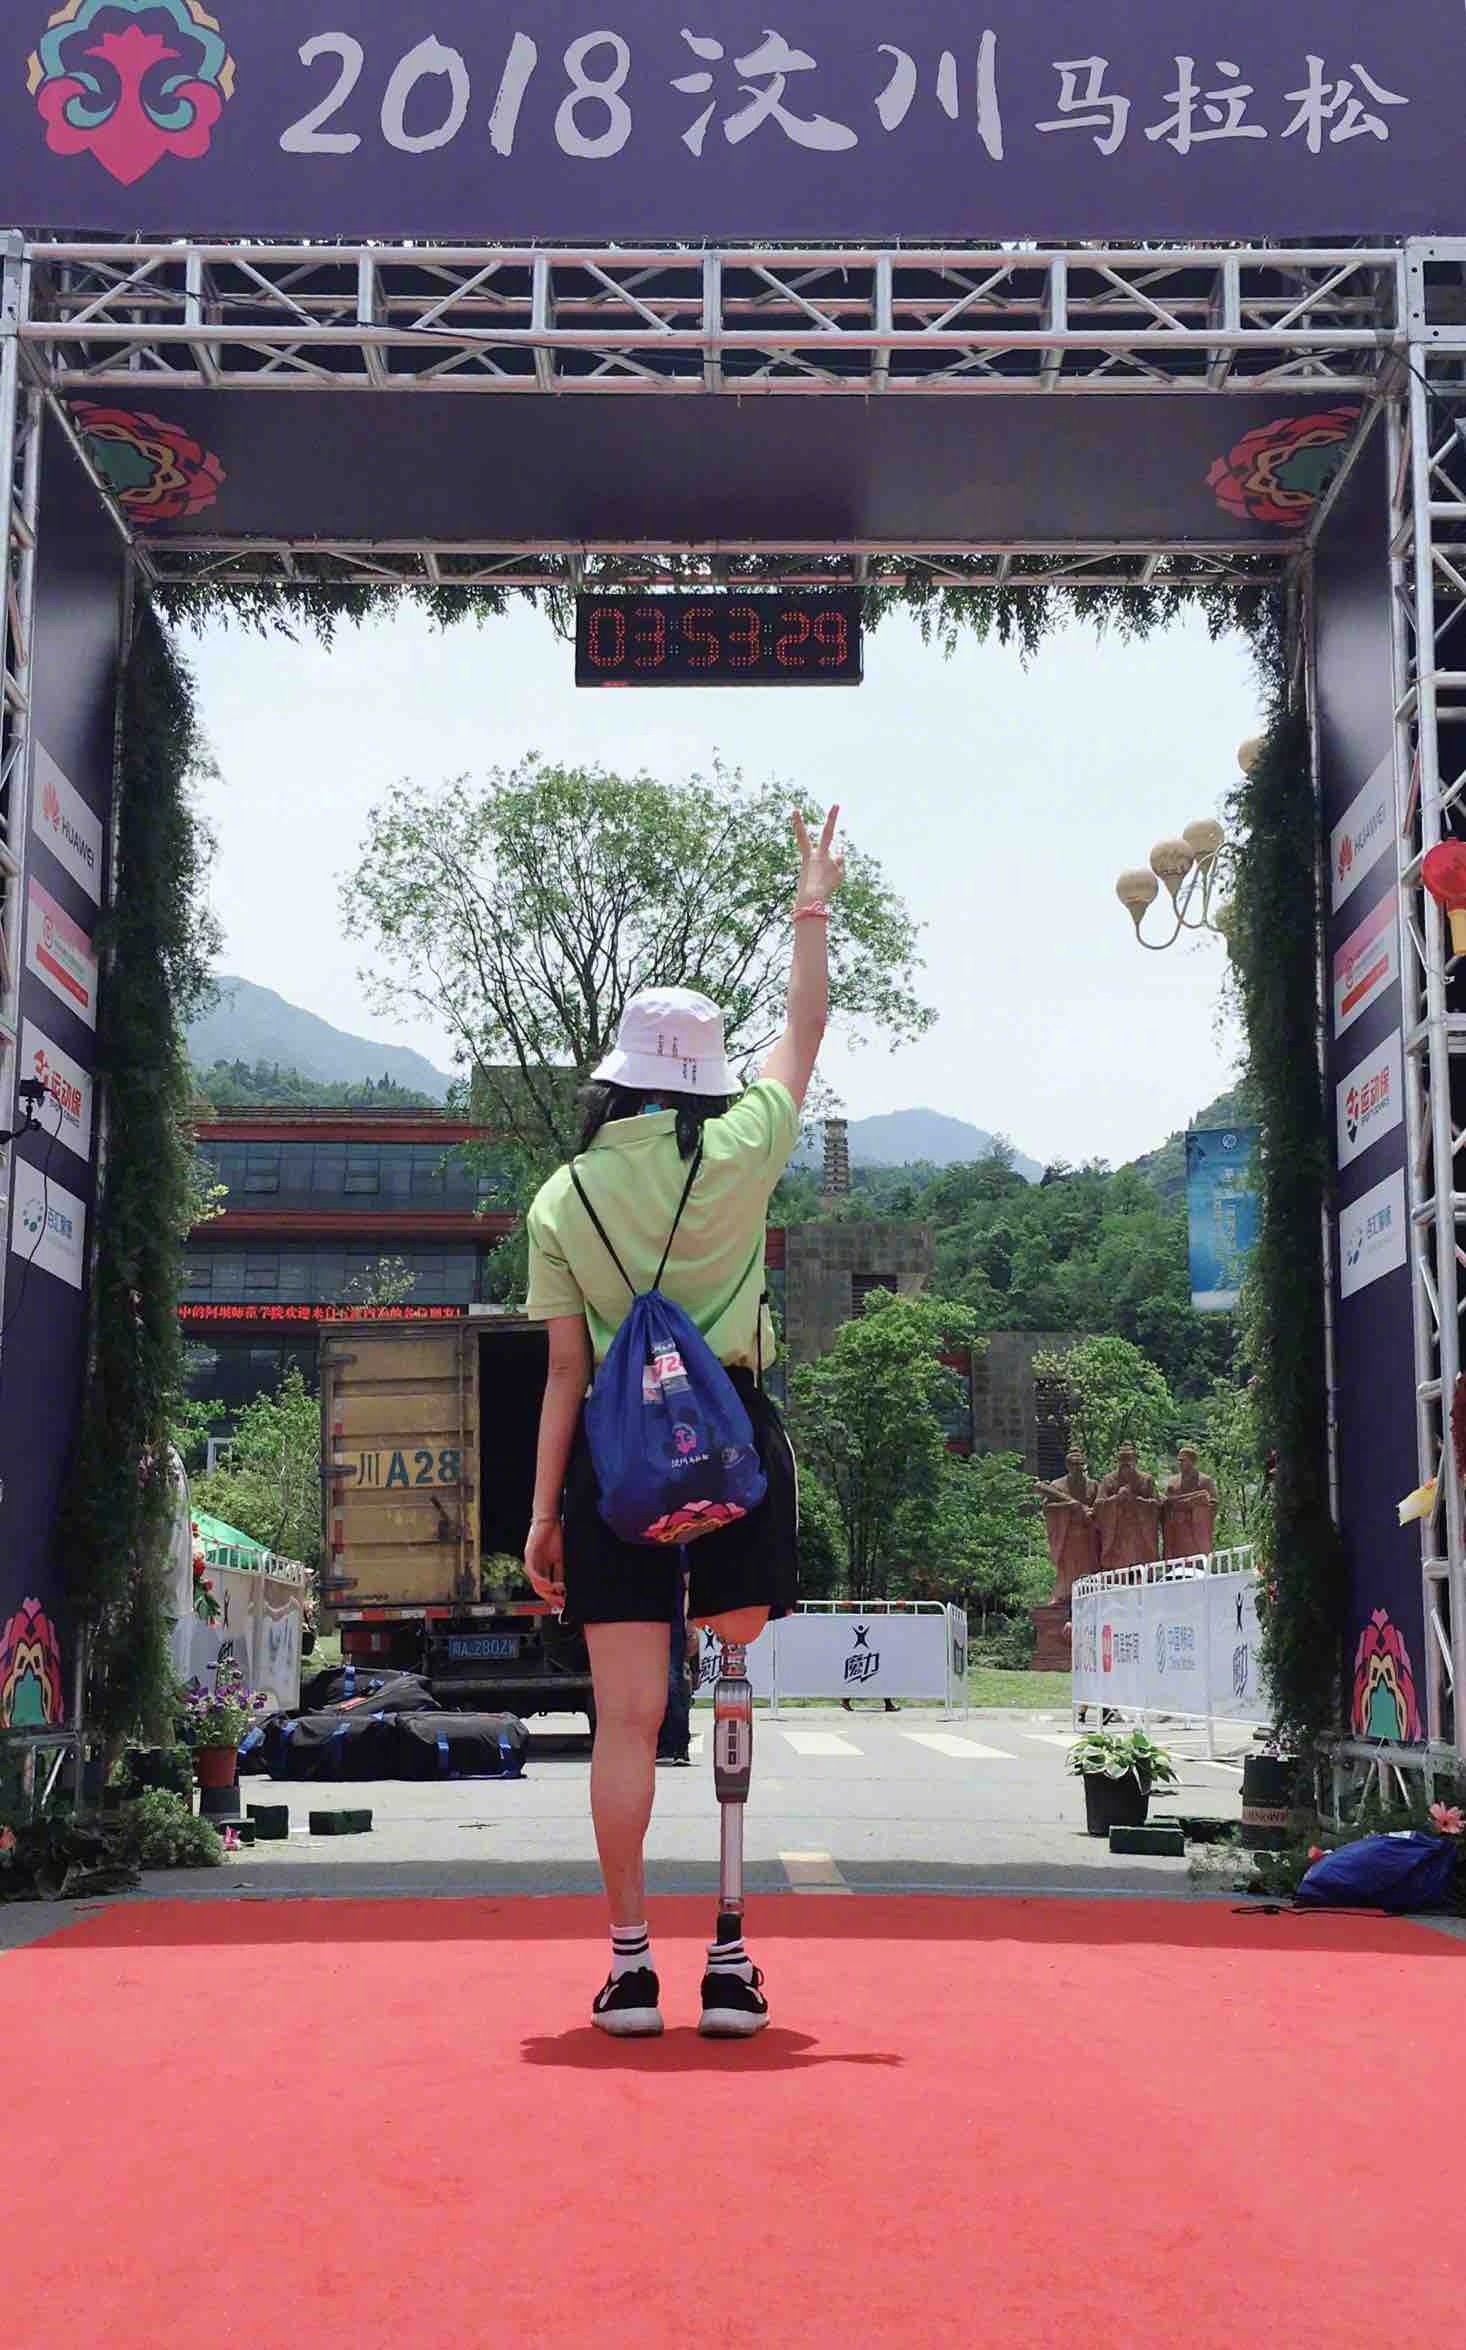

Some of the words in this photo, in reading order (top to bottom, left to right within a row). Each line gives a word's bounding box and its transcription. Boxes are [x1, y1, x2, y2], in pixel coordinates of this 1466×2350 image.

[588, 607, 848, 667] 03:53:29
[62, 816, 95, 871] HUAWEI
[844, 1652, 880, 1685] 魔力
